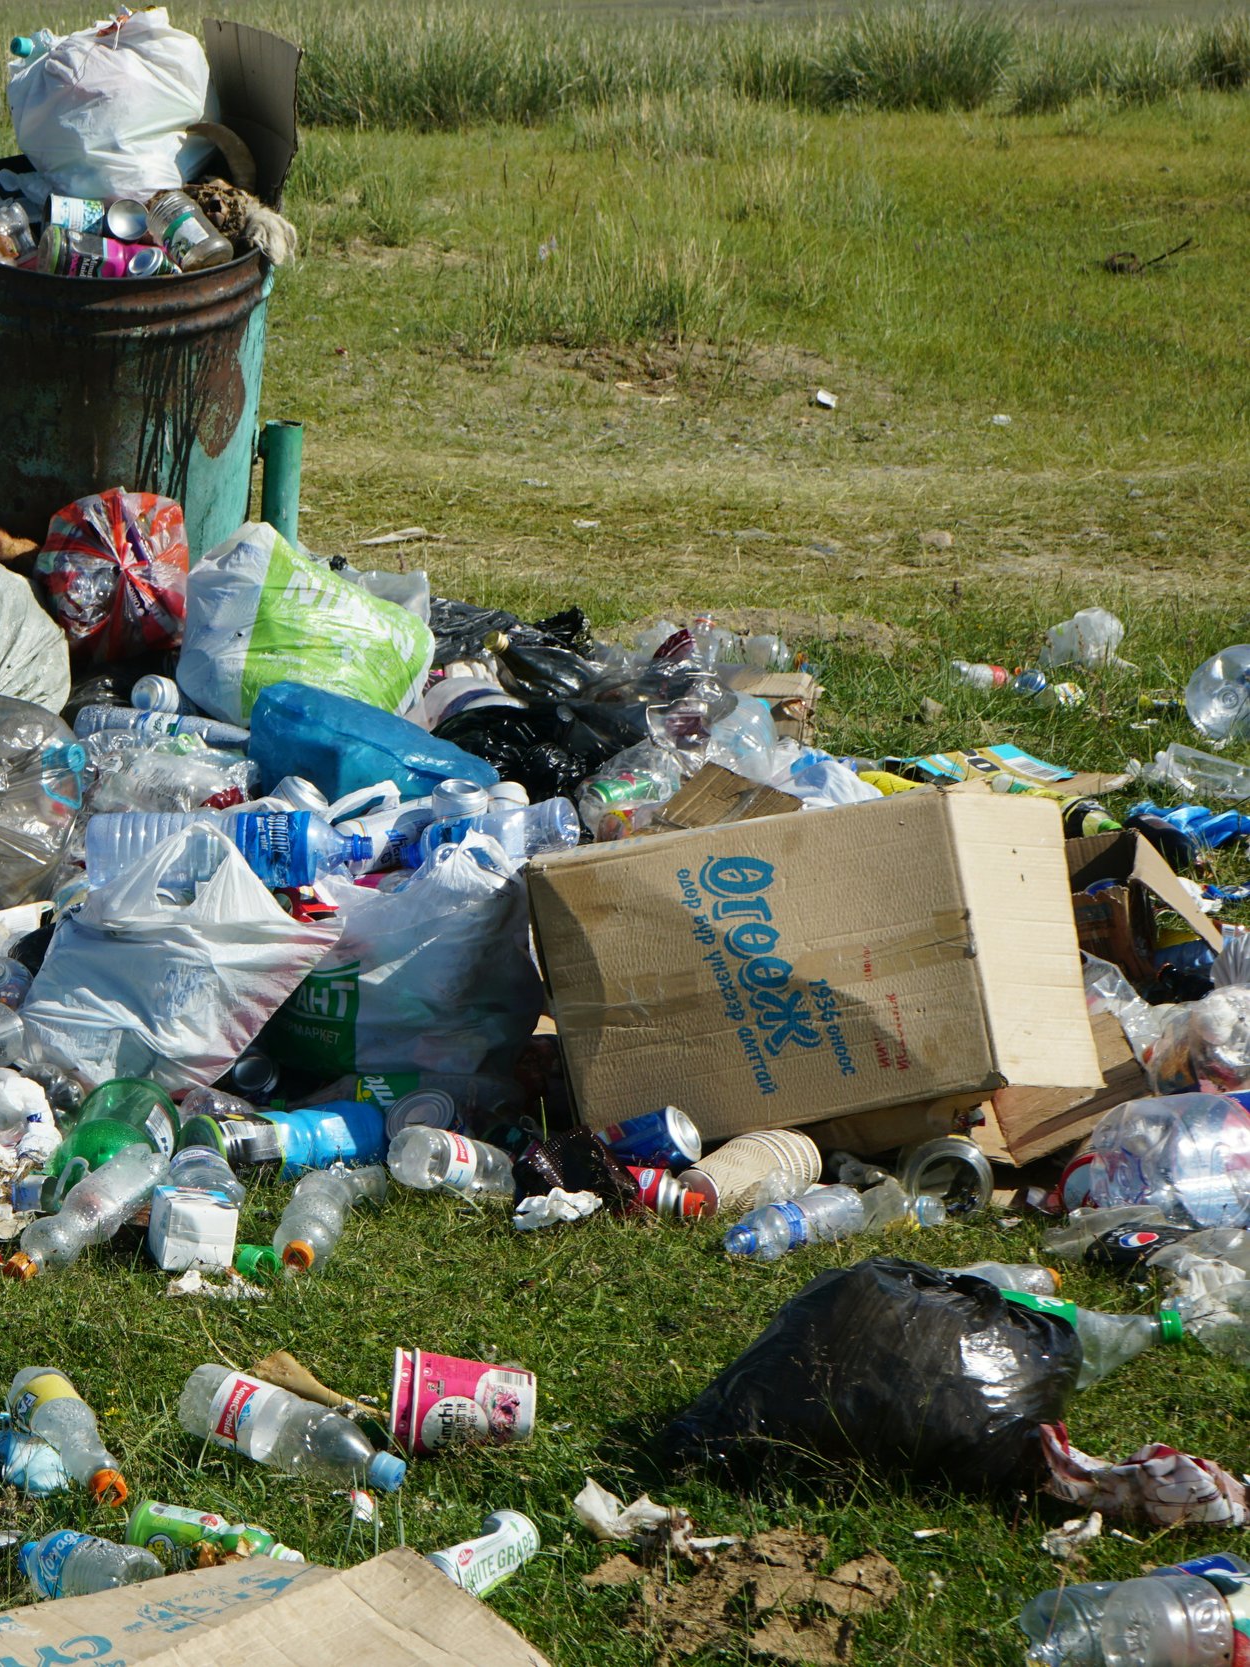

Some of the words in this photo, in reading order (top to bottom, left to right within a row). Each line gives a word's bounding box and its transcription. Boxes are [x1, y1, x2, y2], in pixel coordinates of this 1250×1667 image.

[296, 980, 356, 1018] АНТ
[808, 978, 841, 1022] 1936
[221, 1382, 251, 1439] AquaCrystal
[496, 1531, 535, 1568] GRAPE
